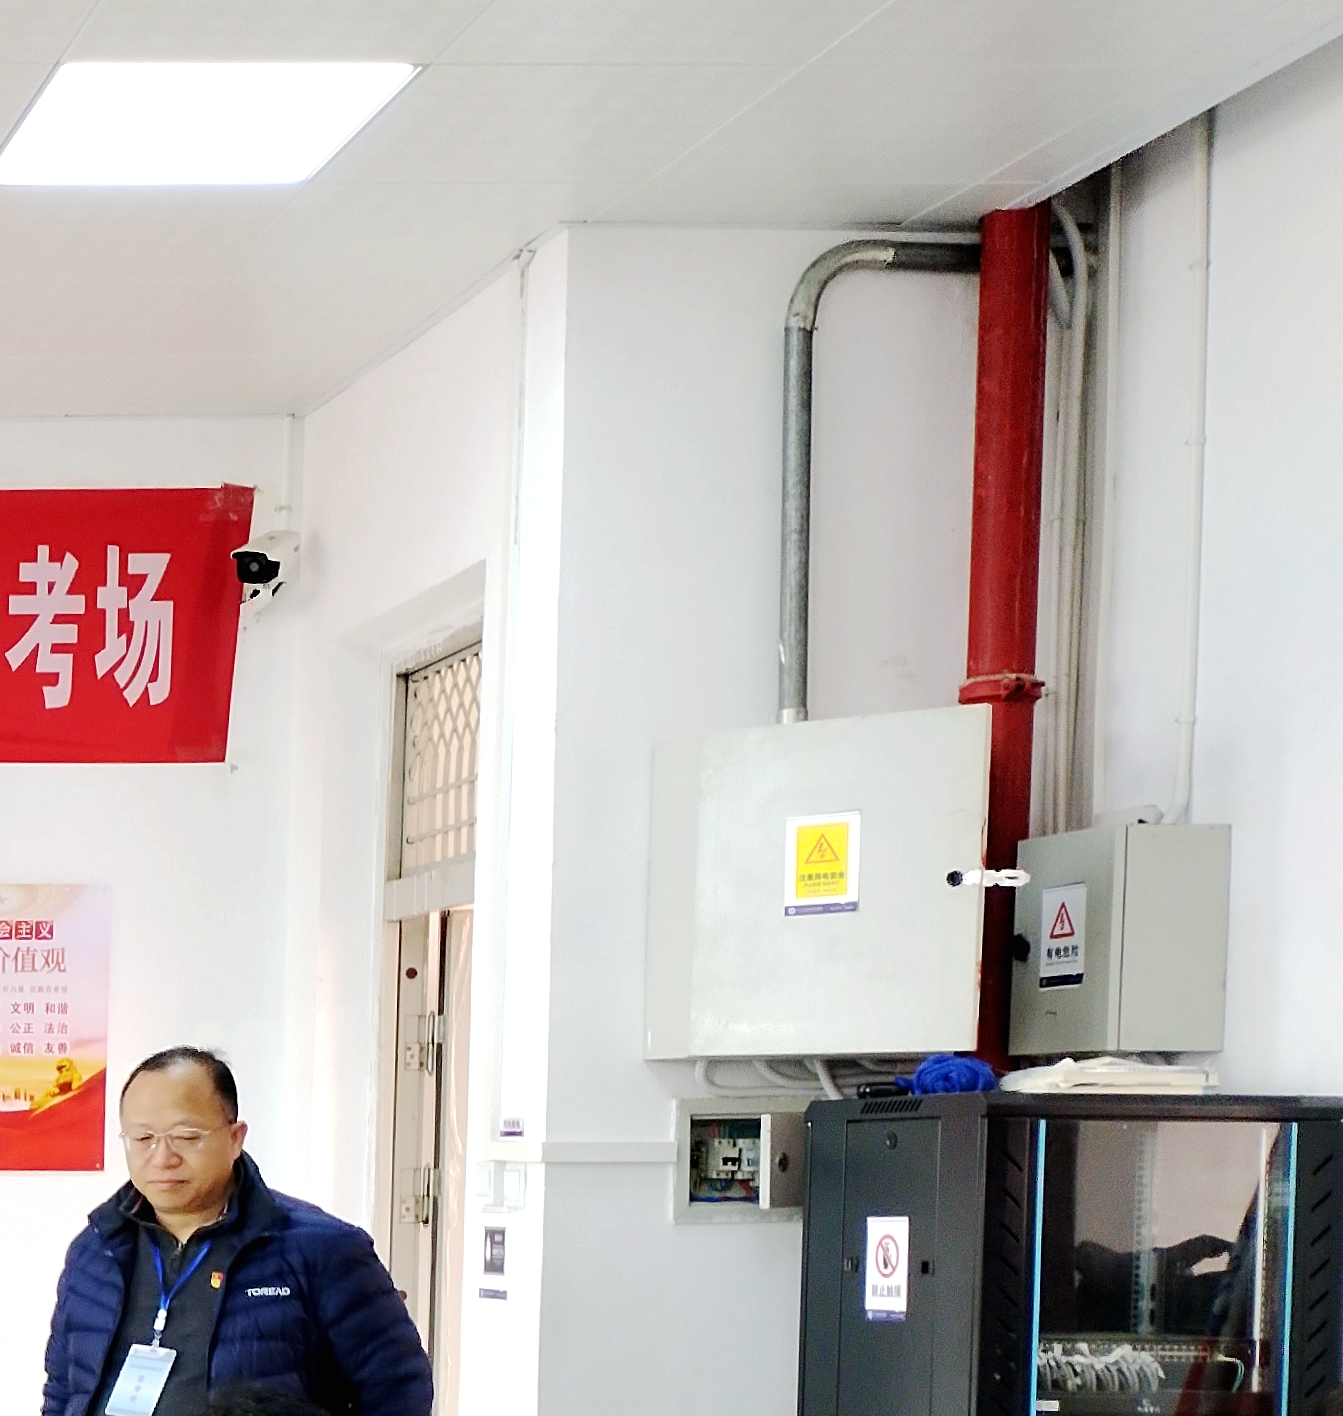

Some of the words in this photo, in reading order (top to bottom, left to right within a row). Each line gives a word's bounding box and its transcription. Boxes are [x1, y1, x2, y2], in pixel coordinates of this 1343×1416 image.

[10, 1002, 35, 1015] 文明
[44, 1002, 69, 1015] 和谐
[10, 1022, 35, 1035] 公正
[44, 1022, 69, 1035] 法治
[10, 1042, 35, 1055] 诚信
[44, 1042, 69, 1055] 友善
[245, 1287, 291, 1297] TOREAD
